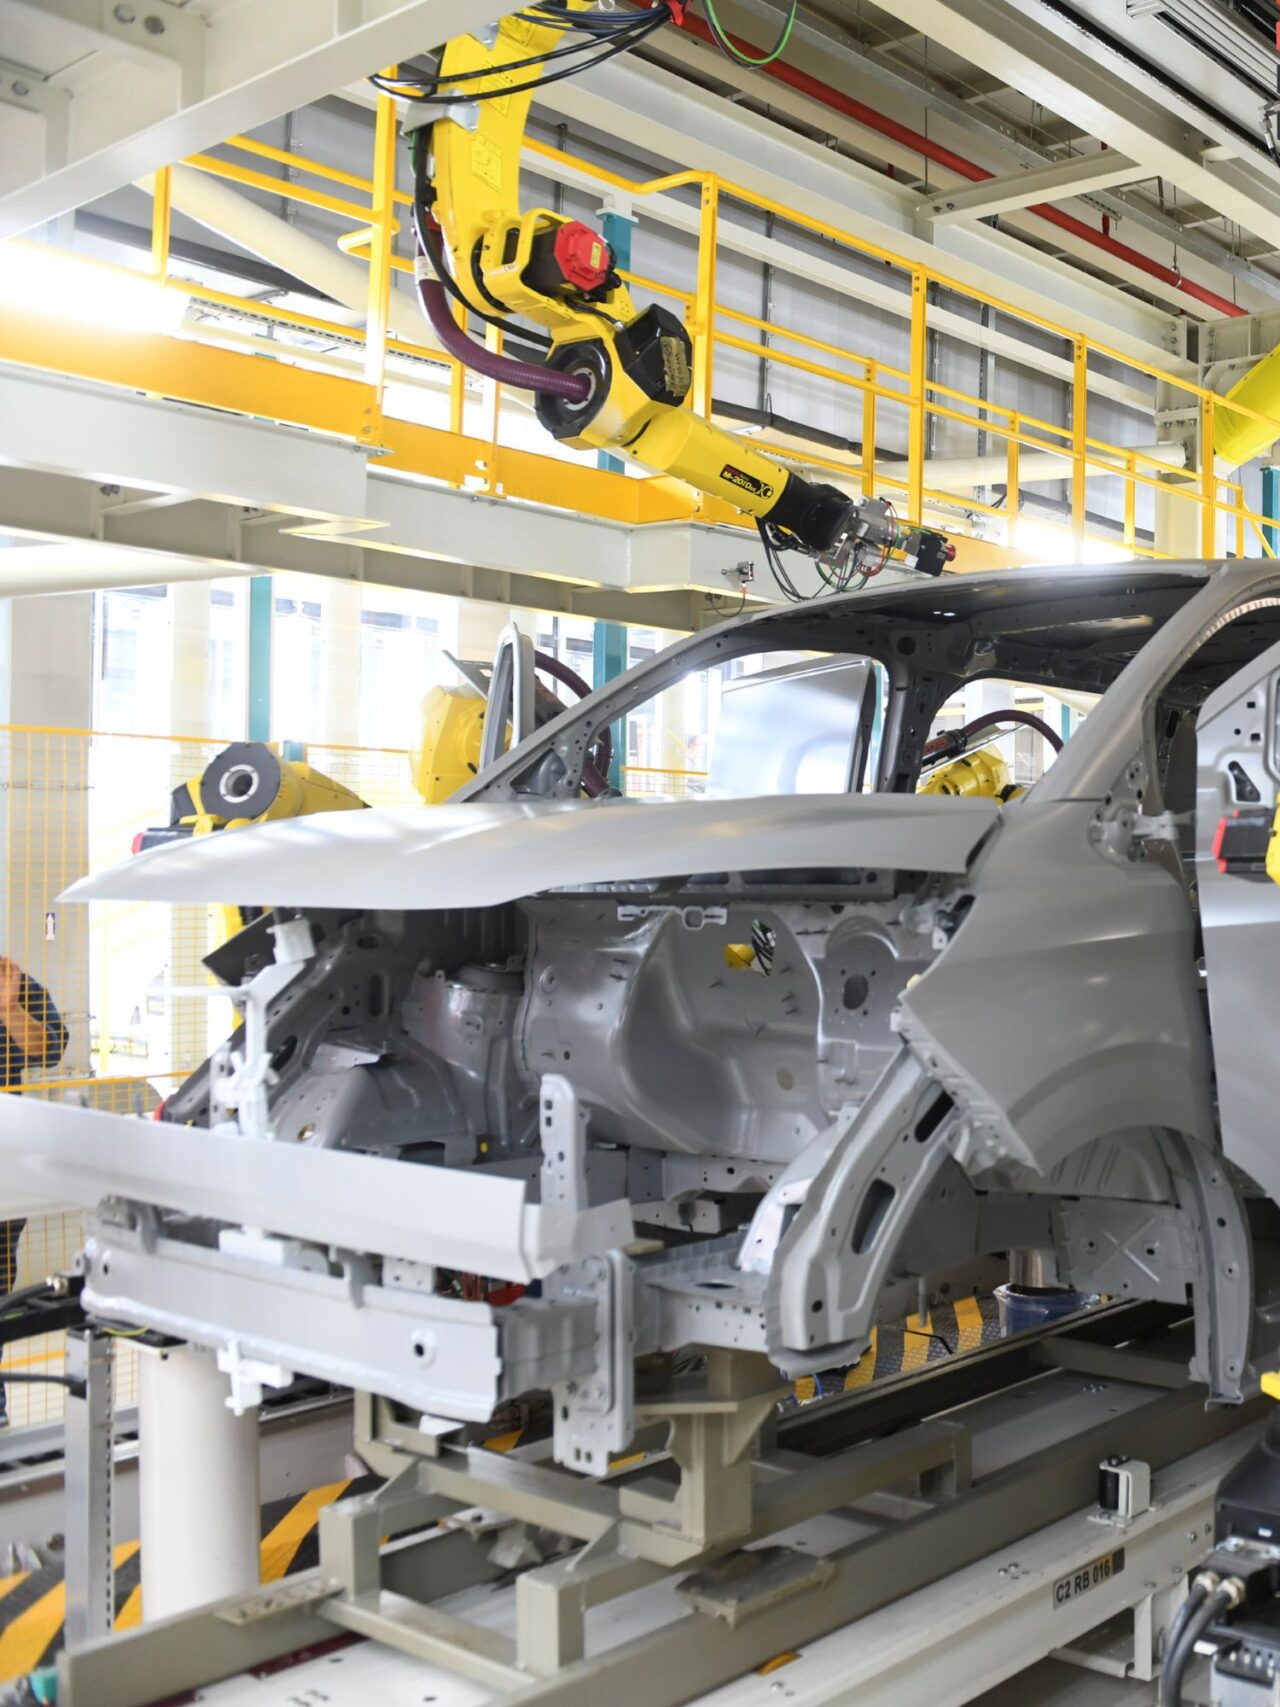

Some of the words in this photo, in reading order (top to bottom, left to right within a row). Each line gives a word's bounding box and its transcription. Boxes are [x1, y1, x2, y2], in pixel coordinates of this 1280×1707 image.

[1056, 1581, 1071, 1603] C2
[1074, 1570, 1090, 1595] RB
[1093, 1558, 1110, 1583] 016
